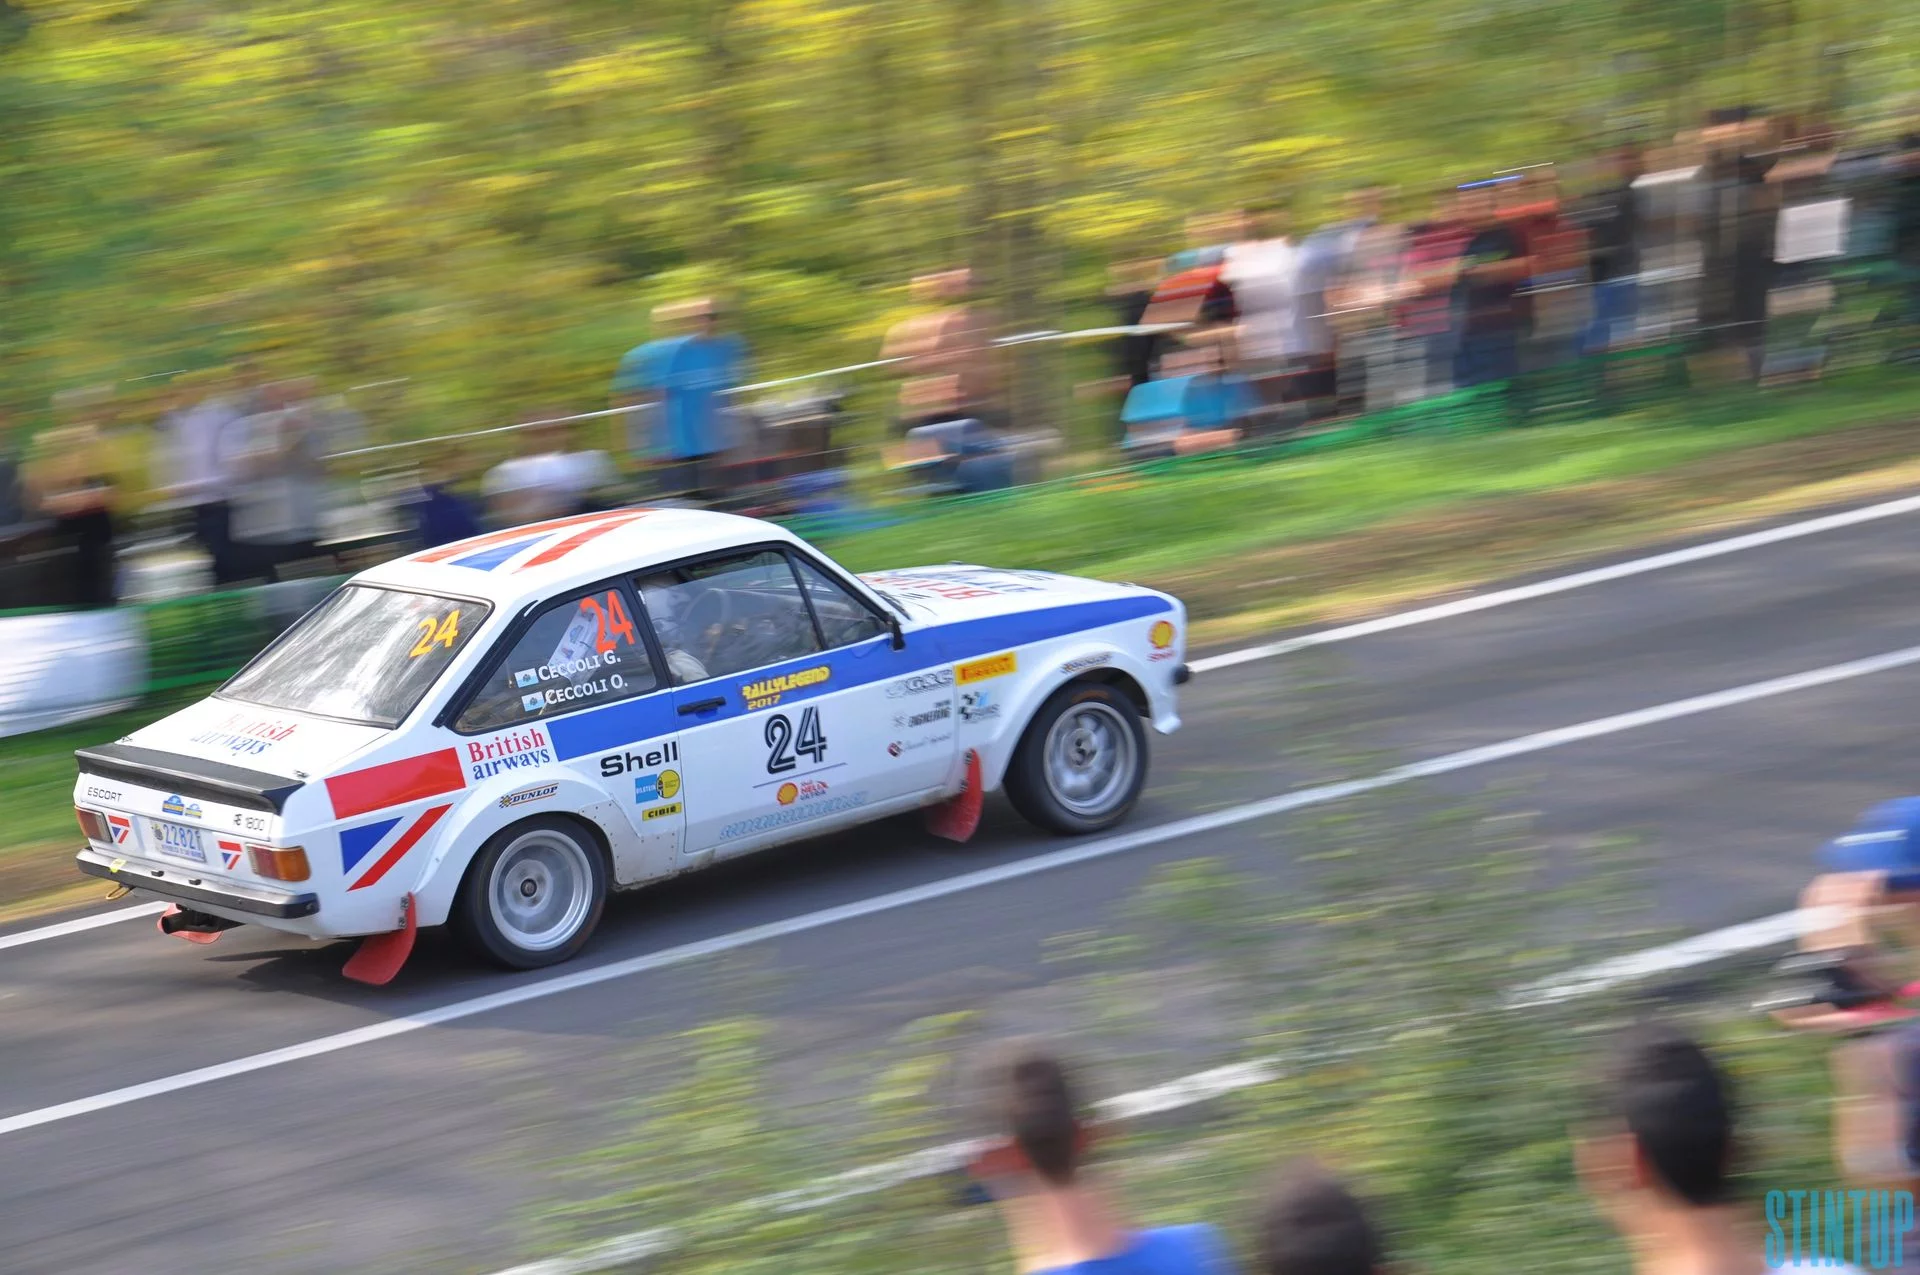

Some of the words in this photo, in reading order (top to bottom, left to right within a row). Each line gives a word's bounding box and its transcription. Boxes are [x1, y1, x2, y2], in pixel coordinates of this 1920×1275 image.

[409, 610, 460, 658] 24
[580, 590, 636, 653] 24
[538, 656, 601, 681] CECCOLI
[604, 650, 621, 665] G.
[742, 665, 831, 699] RALLYLEGEND
[545, 677, 608, 705] CECCOLI
[611, 674, 628, 689] O.
[747, 694, 781, 711] 2017
[217, 713, 298, 741] Bitish
[764, 705, 828, 775] 24
[466, 728, 546, 763] British
[600, 741, 678, 777] Shell
[472, 747, 551, 781] airways
[87, 786, 122, 802] ESCORT
[512, 786, 558, 803] DUNLOP
